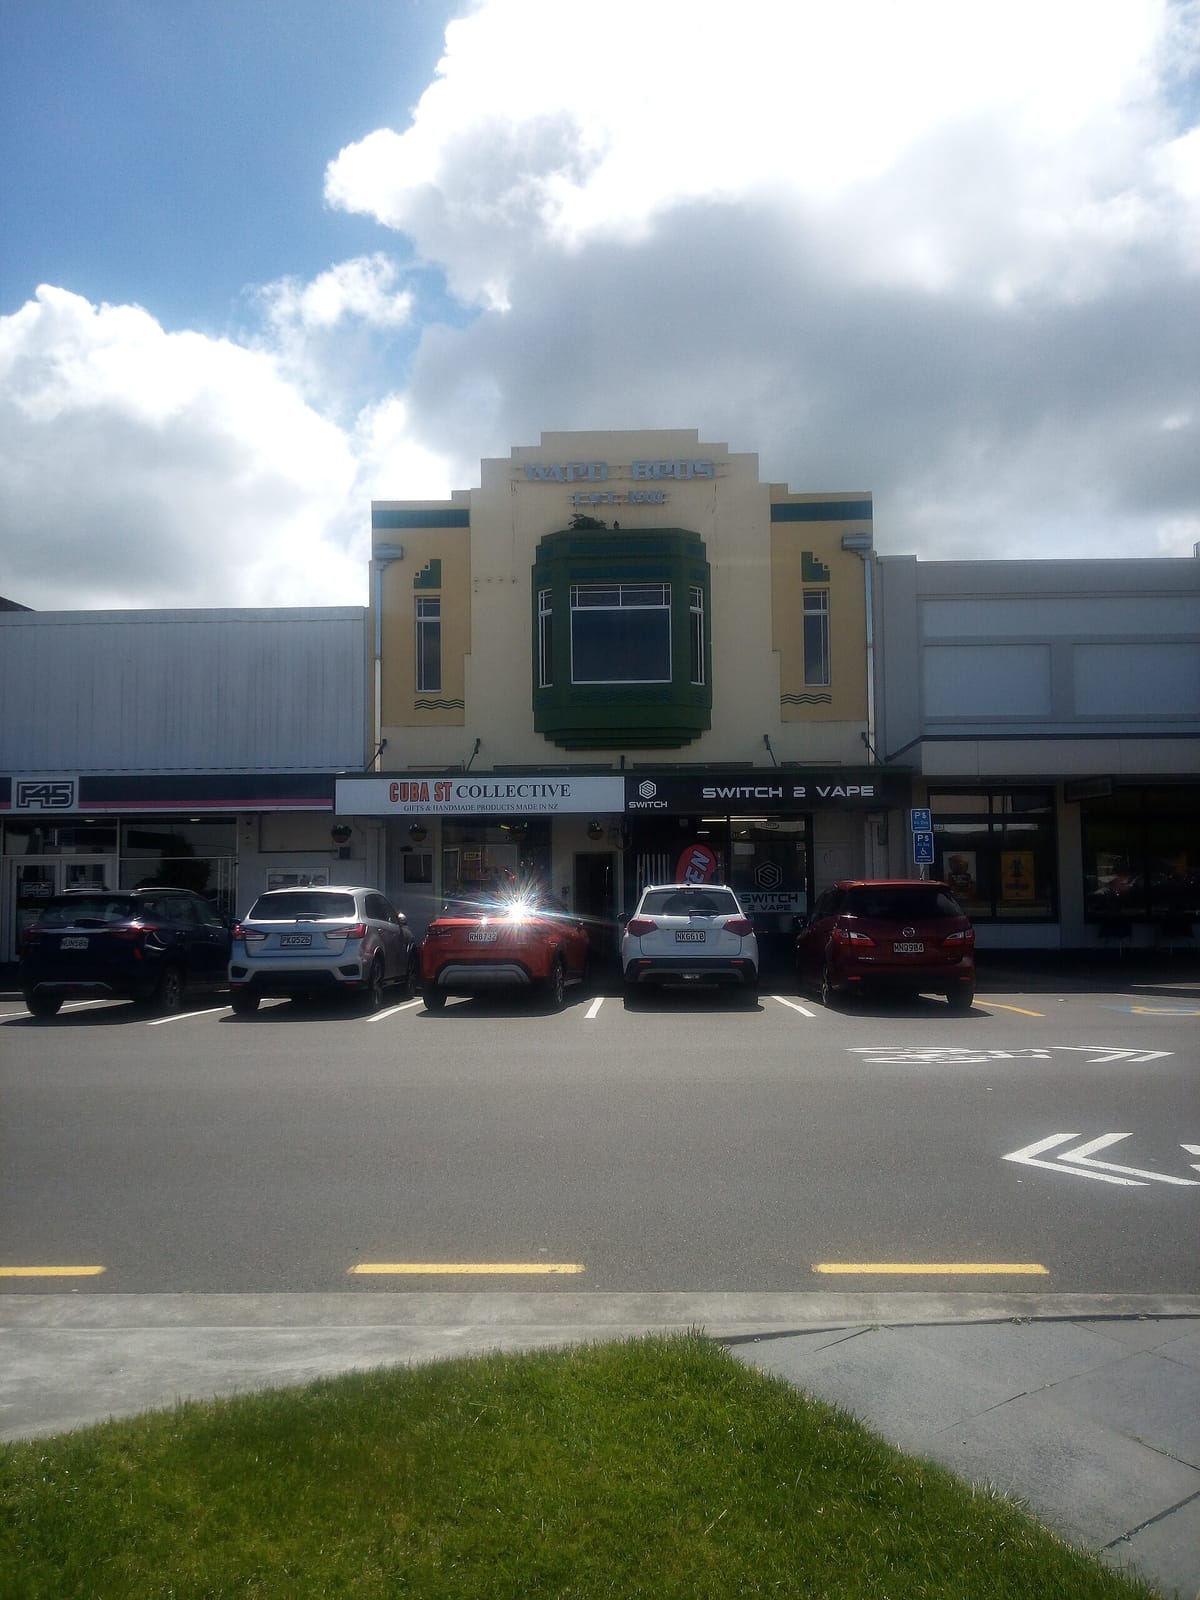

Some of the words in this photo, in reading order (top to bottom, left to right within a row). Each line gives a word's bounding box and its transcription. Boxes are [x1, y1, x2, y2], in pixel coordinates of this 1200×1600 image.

[16, 780, 75, 809] F45
[389, 782, 430, 803] CUBA
[434, 781, 453, 802] ST
[456, 784, 571, 799] COLLECTIVE
[702, 786, 783, 799] SWITCH
[793, 786, 806, 798] 2
[816, 785, 875, 797] VAPE
[403, 804, 425, 812] GIFTS
[433, 804, 475, 812] HANDMADE
[476, 803, 515, 812] PRODUCTS
[516, 803, 537, 811] MADE
[538, 803, 547, 811] IN
[628, 801, 668, 809] SWITCH
[684, 849, 711, 884] EN
[741, 893, 799, 904] SWITCH
